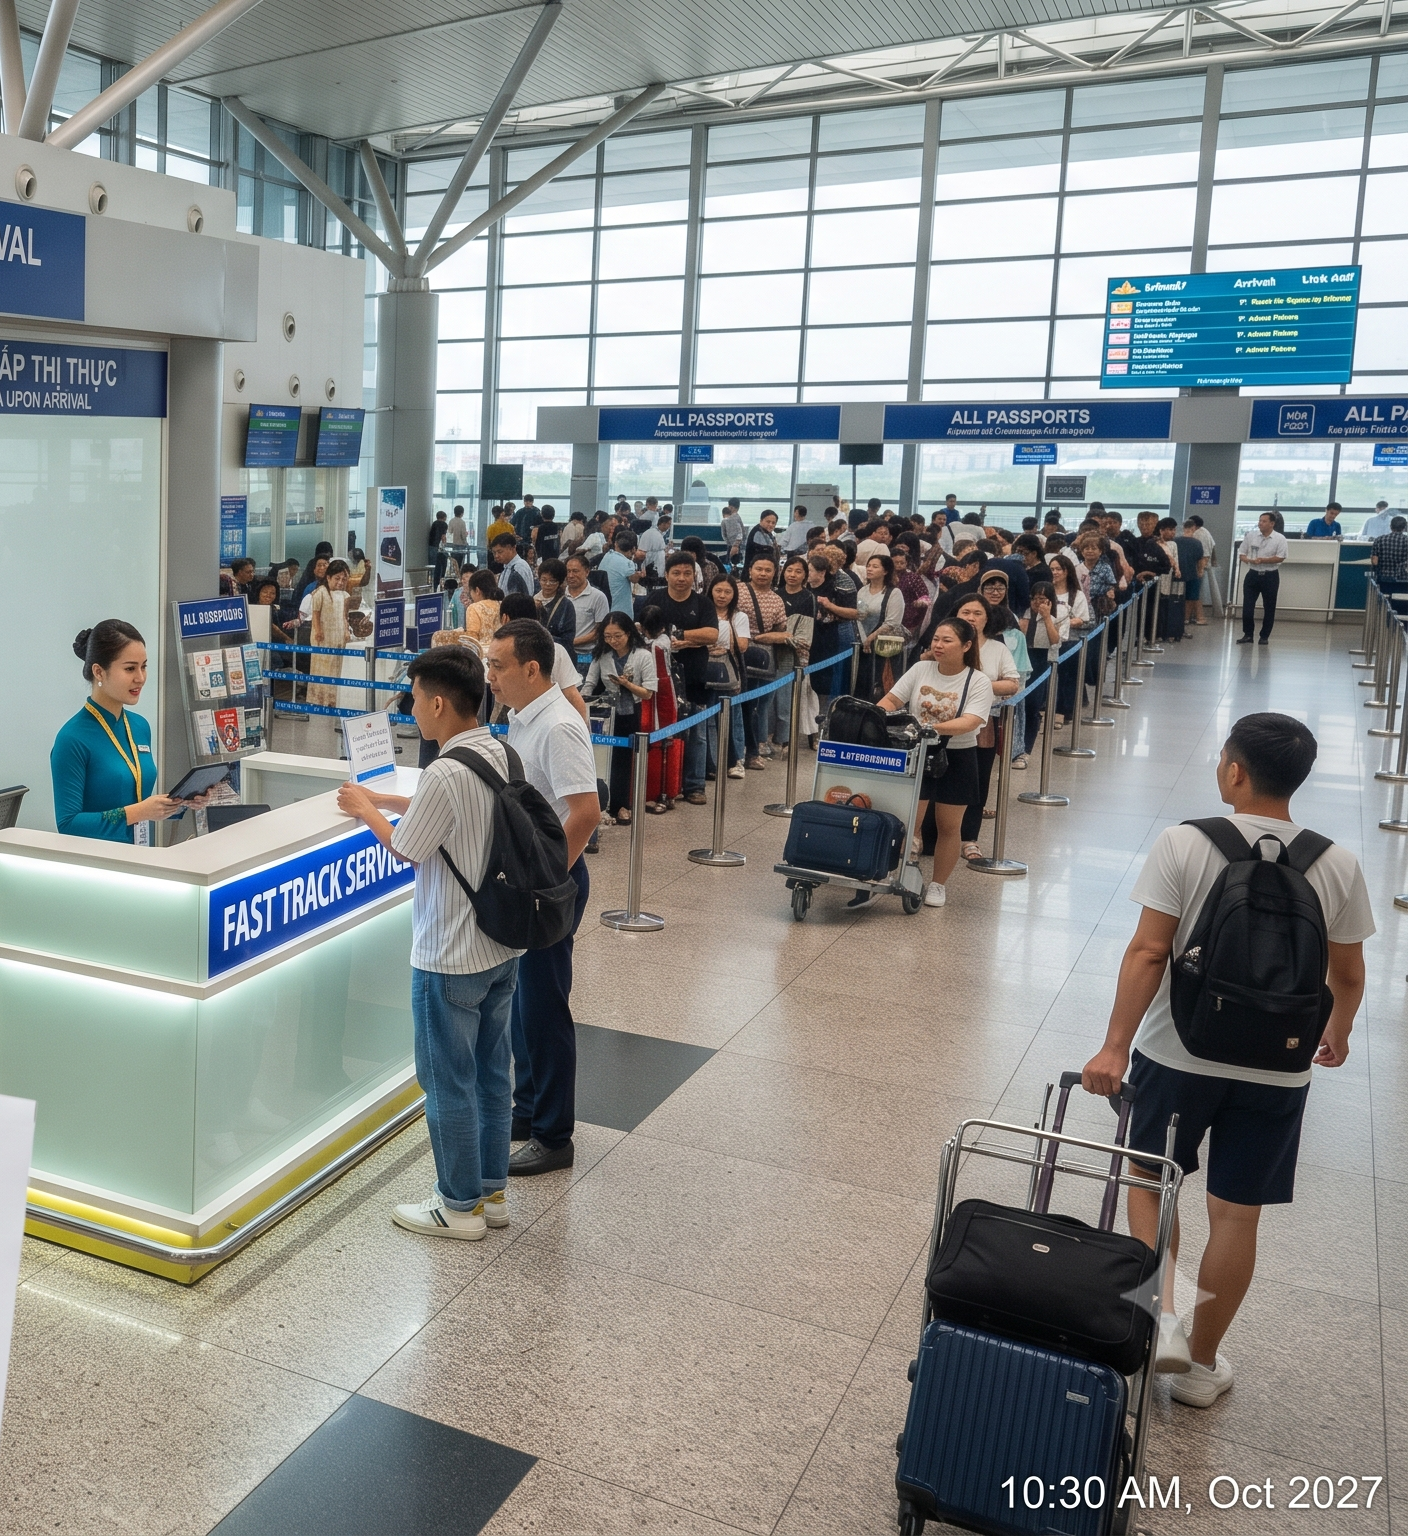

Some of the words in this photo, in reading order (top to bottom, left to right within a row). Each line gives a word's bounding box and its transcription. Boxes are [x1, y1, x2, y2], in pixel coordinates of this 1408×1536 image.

[31, 355, 61, 391] THỊ
[66, 357, 117, 393] THỰC
[6, 390, 41, 408] UPON
[43, 392, 92, 410] ARRIVAL
[657, 413, 684, 427] ALL
[688, 412, 775, 427] PASSPORTS
[951, 410, 982, 425] ALL
[986, 409, 1091, 424] PASSPORTS
[1344, 405, 1384, 422] ALL
[183, 612, 198, 626] ALL
[223, 887, 276, 951] FAST
[276, 858, 343, 925] TRACK
[345, 842, 412, 896] SERVIC
